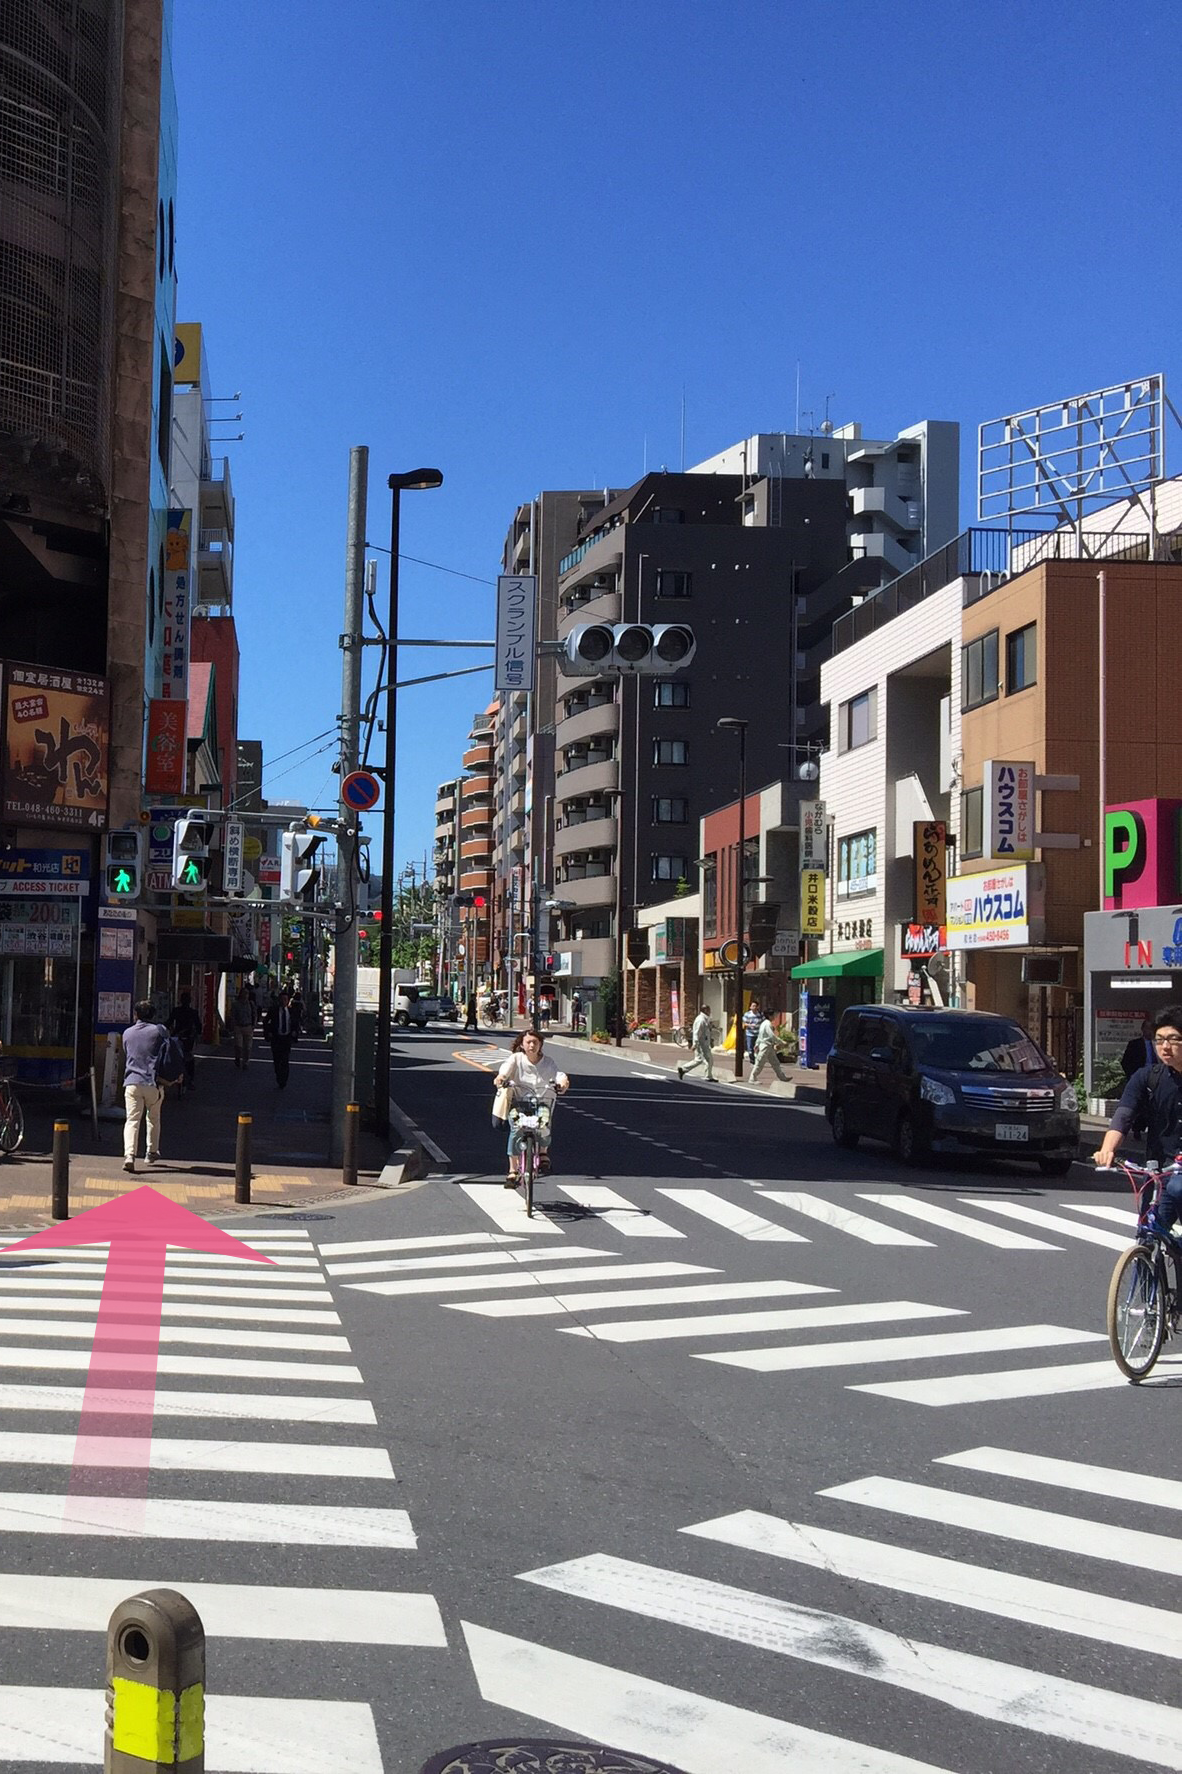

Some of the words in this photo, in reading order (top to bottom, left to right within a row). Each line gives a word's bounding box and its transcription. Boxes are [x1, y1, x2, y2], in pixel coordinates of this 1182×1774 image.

[173, 576, 186, 679] 処方せん調剤
[504, 580, 524, 686] スクランブル信号
[12, 669, 73, 690] 個室居酒屋
[156, 711, 178, 773] 美容室
[88, 811, 106, 828] 4F
[997, 766, 1015, 853] ハウスコム
[1017, 768, 1028, 843] お部屋さがしは
[149, 872, 174, 889] ATM
[227, 825, 241, 887] 斜め横断専用
[1105, 810, 1139, 897] P
[13, 882, 46, 892] ACCESS
[49, 883, 80, 892] TICKET
[806, 873, 819, 928] 井口米穀店
[973, 889, 1024, 924] ハウスコム
[1124, 940, 1153, 968] IN
